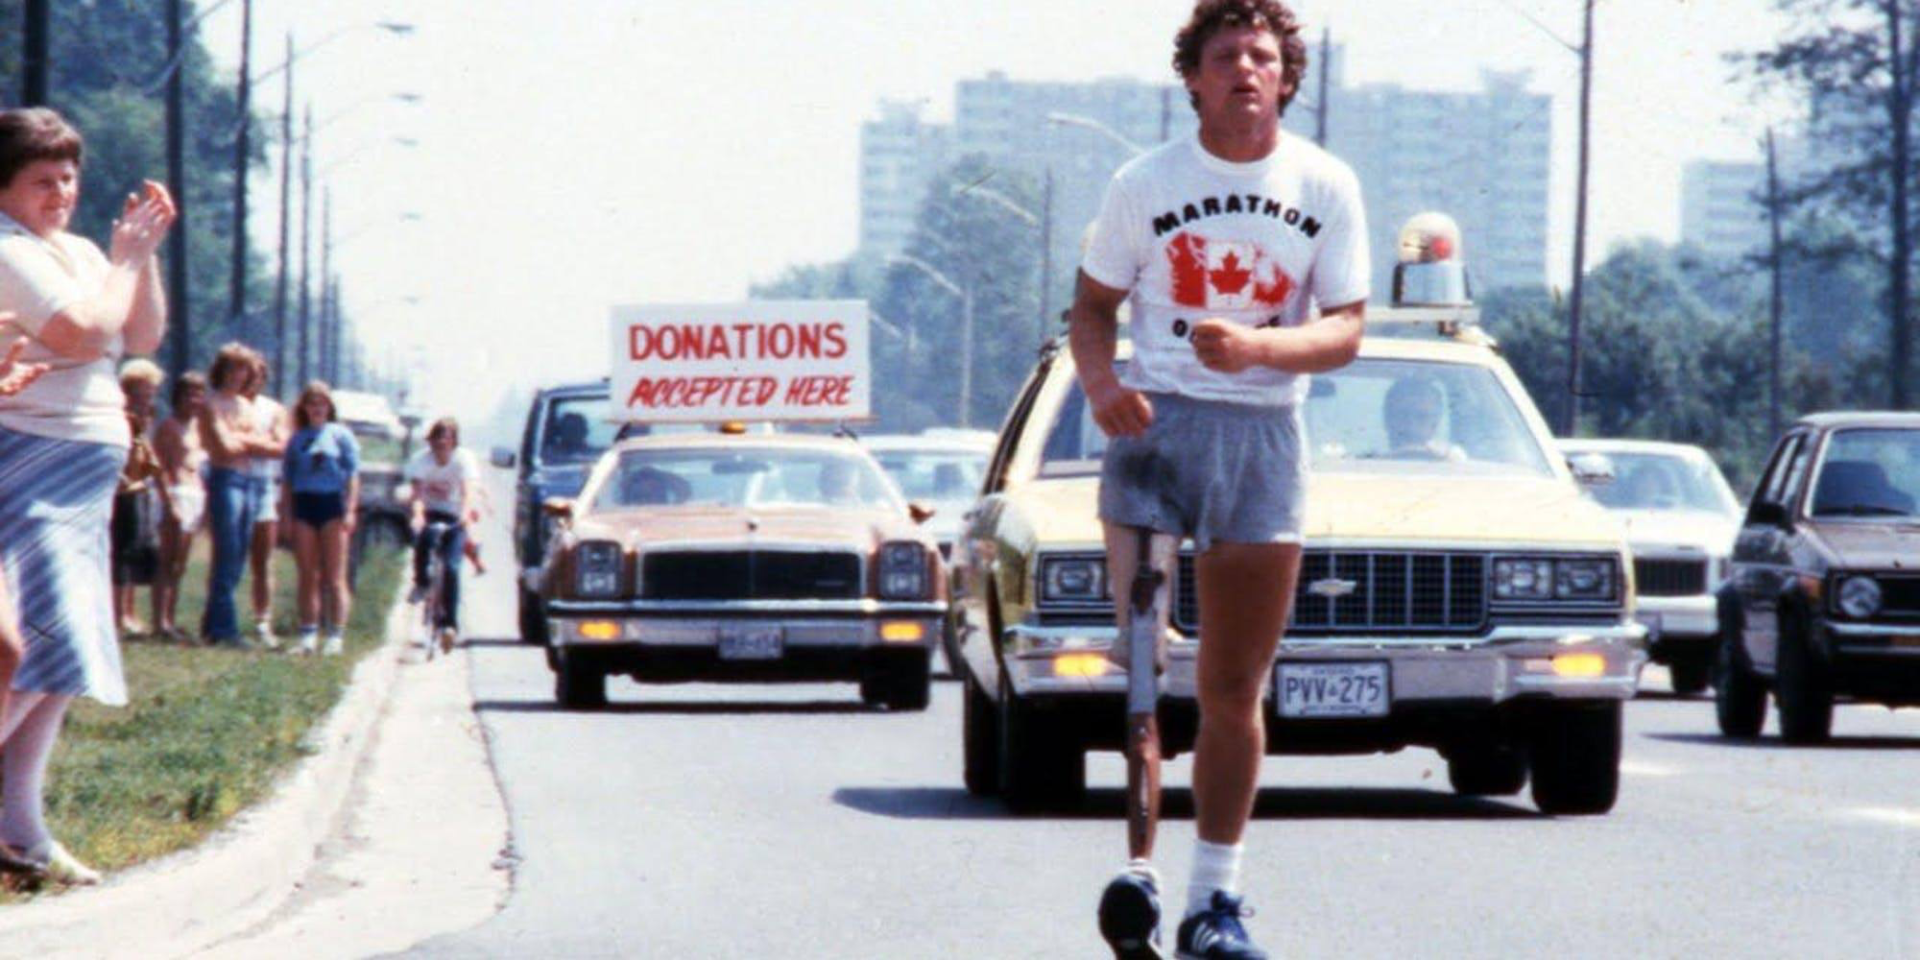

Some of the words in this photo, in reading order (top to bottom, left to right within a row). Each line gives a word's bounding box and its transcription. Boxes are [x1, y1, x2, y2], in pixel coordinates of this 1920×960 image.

[1153, 195, 1322, 238] MARATHON
[628, 323, 848, 361] DONATIONS
[627, 375, 778, 409] ACCEPTED
[784, 375, 855, 407] HERE
